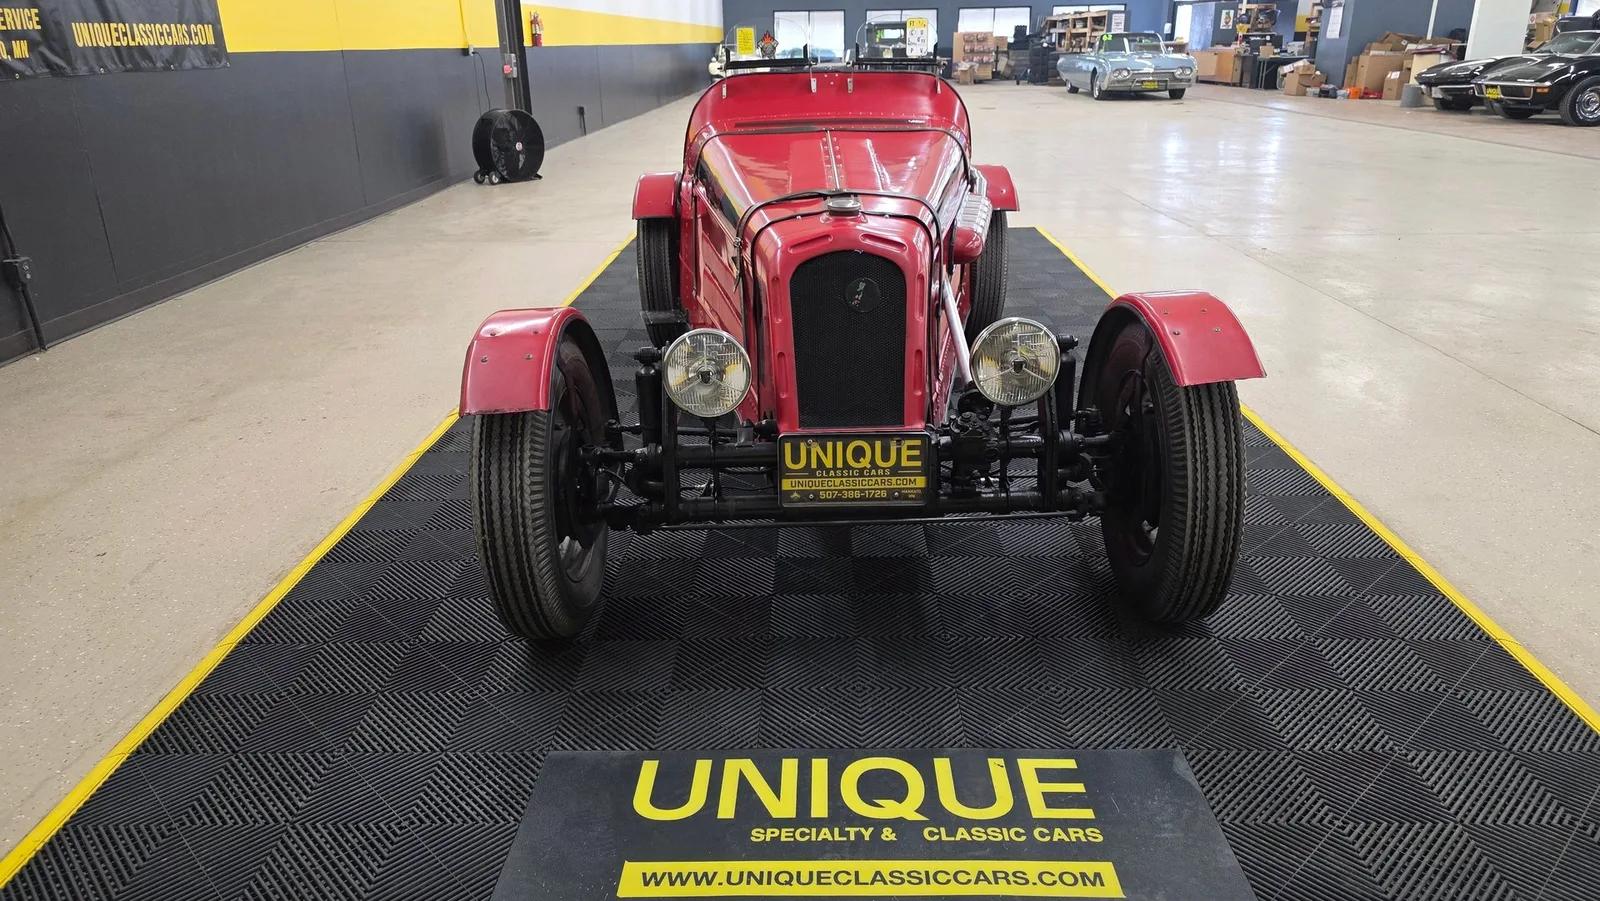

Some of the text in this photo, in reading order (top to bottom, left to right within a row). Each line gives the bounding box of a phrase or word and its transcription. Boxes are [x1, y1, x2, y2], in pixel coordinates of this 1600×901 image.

[71, 22, 215, 47] UNIQUECLASSICCARS.COM
[12, 40, 29, 58] MN
[784, 439, 922, 470] UNIQUE
[790, 478, 917, 488] UNIQUECLASSICCARS.COM
[819, 490, 887, 499] 507-386-1726
[632, 757, 1096, 821] UNIQUE
[750, 826, 1104, 843] SPECIALTY & CLASSIC CARS
[641, 870, 1106, 888] WWW.UNIQUECLASSICCARS.COM
